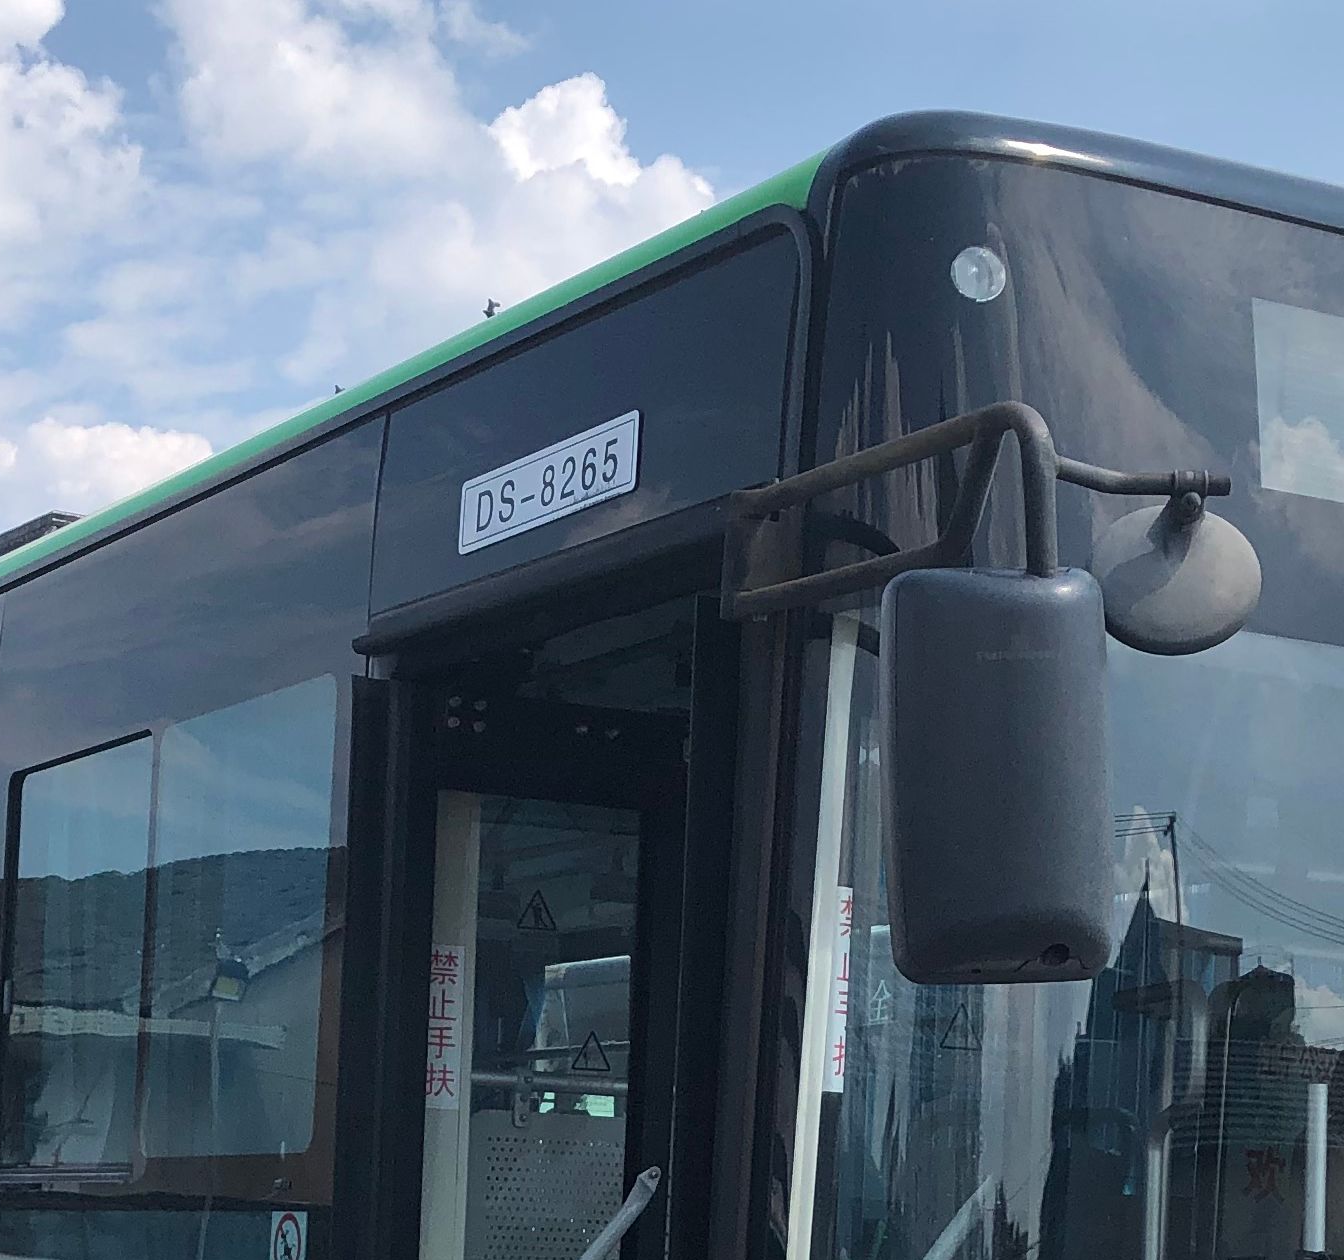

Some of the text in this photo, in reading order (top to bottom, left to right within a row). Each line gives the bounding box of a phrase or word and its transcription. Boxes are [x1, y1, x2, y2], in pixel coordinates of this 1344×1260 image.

[476, 437, 618, 532] DS-8265
[425, 949, 459, 1097] 禁止手扶
